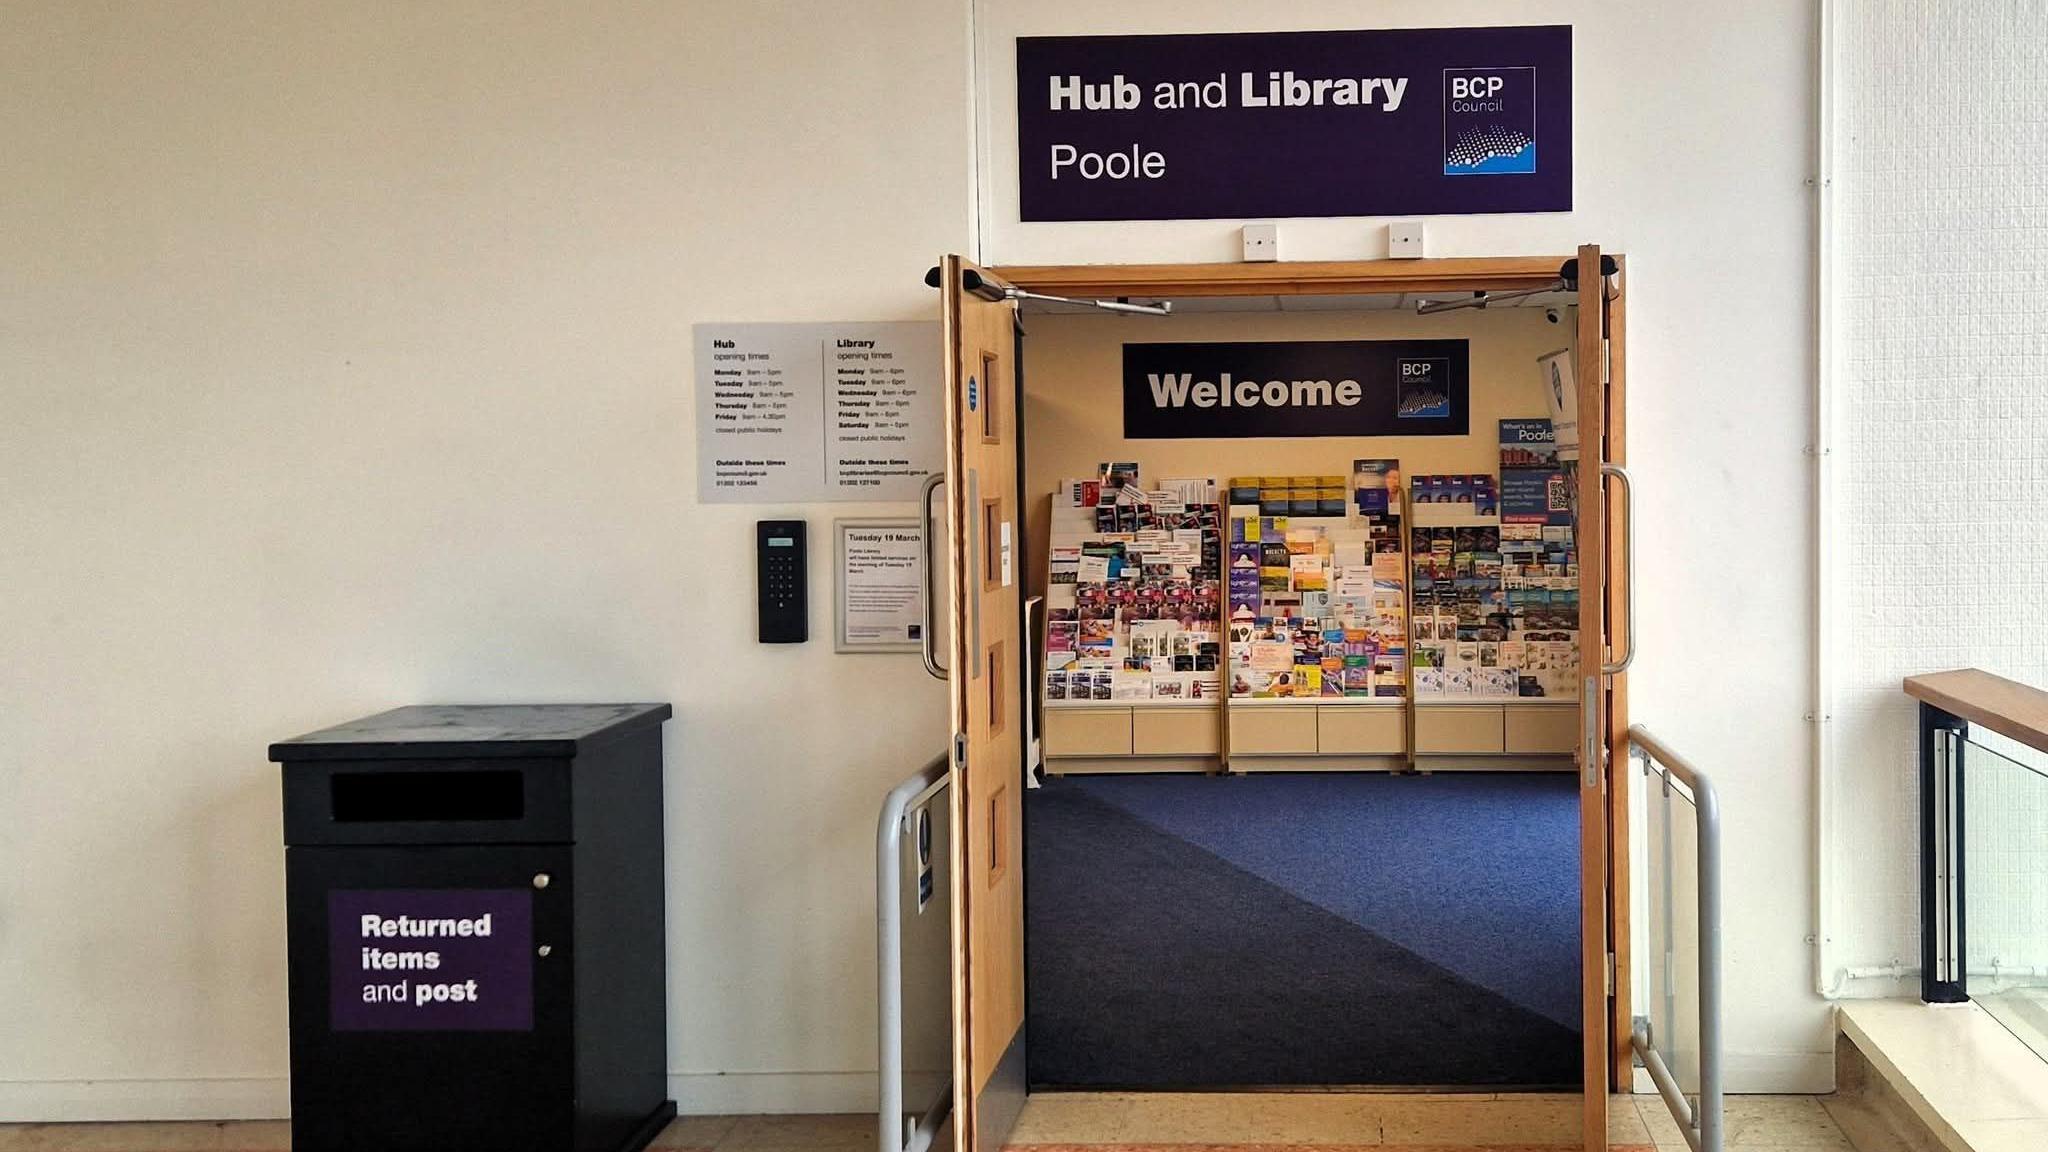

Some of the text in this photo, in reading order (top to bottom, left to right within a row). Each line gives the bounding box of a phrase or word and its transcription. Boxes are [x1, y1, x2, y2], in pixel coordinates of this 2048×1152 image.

[1049, 71, 1408, 111] Hub and Library
[1451, 77, 1504, 98] BCP
[1452, 98, 1504, 113] Council
[1050, 143, 1166, 180] Poole
[713, 339, 735, 349] Hub
[837, 339, 875, 349] Library
[713, 353, 746, 362] opening
[837, 352, 893, 361] opening times
[714, 369, 742, 377] Monday
[837, 368, 865, 376] Monday
[1402, 363, 1432, 376] BCP
[715, 380, 743, 388] Tuesday
[1147, 373, 1362, 407] Welcome
[838, 411, 860, 419] Friday
[1518, 429, 1554, 441] Poole
[849, 534, 882, 543] Tuesday
[361, 913, 492, 938] Returned
[362, 947, 441, 970] items
[362, 979, 478, 1006] and post
